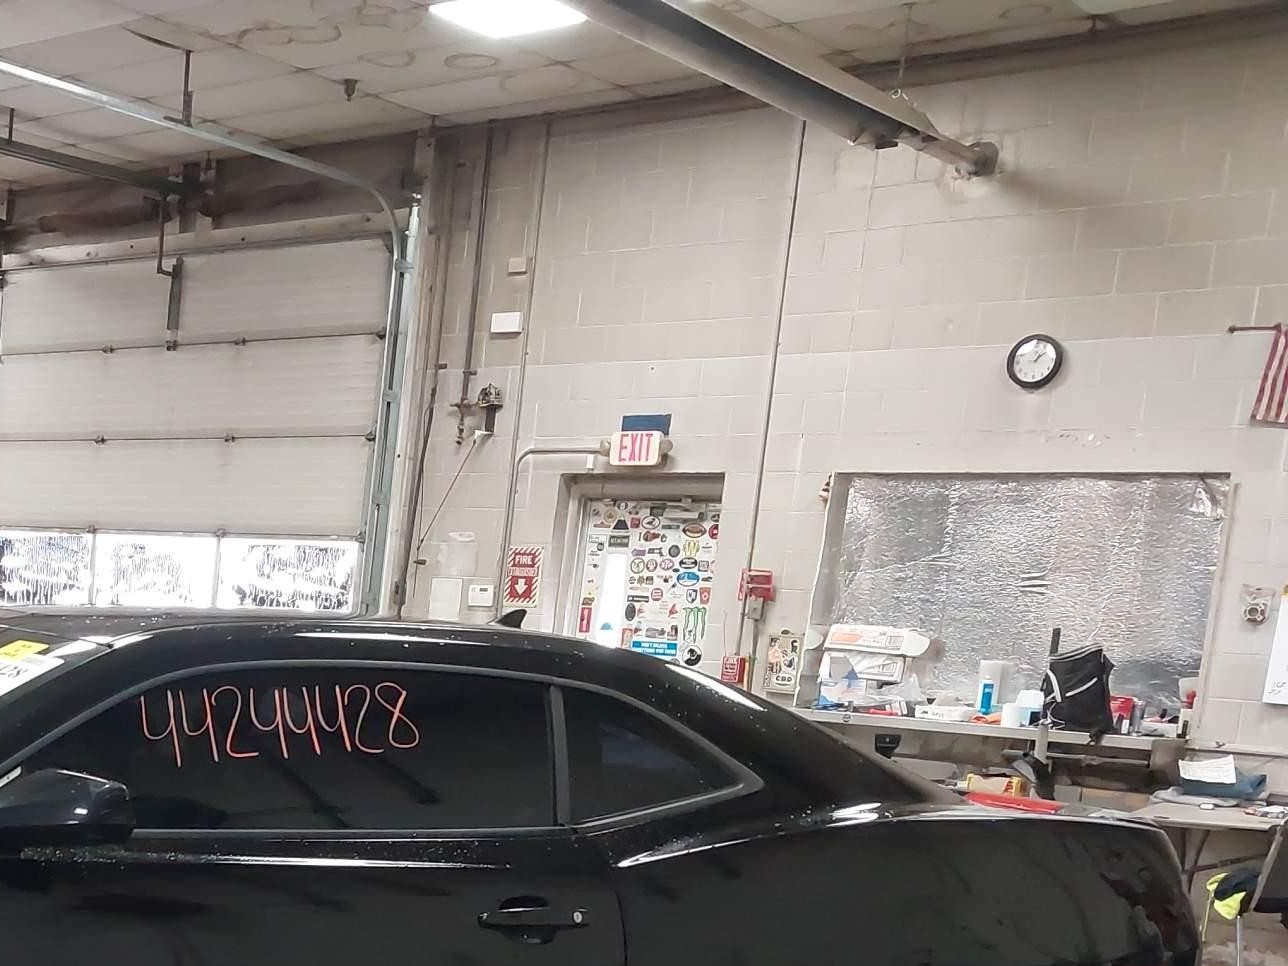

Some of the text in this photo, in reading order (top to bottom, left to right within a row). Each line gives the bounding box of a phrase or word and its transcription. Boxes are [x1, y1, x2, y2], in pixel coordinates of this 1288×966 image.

[618, 433, 654, 463] EXIT
[514, 554, 534, 566] FIRE
[140, 682, 420, 768] 44244428
